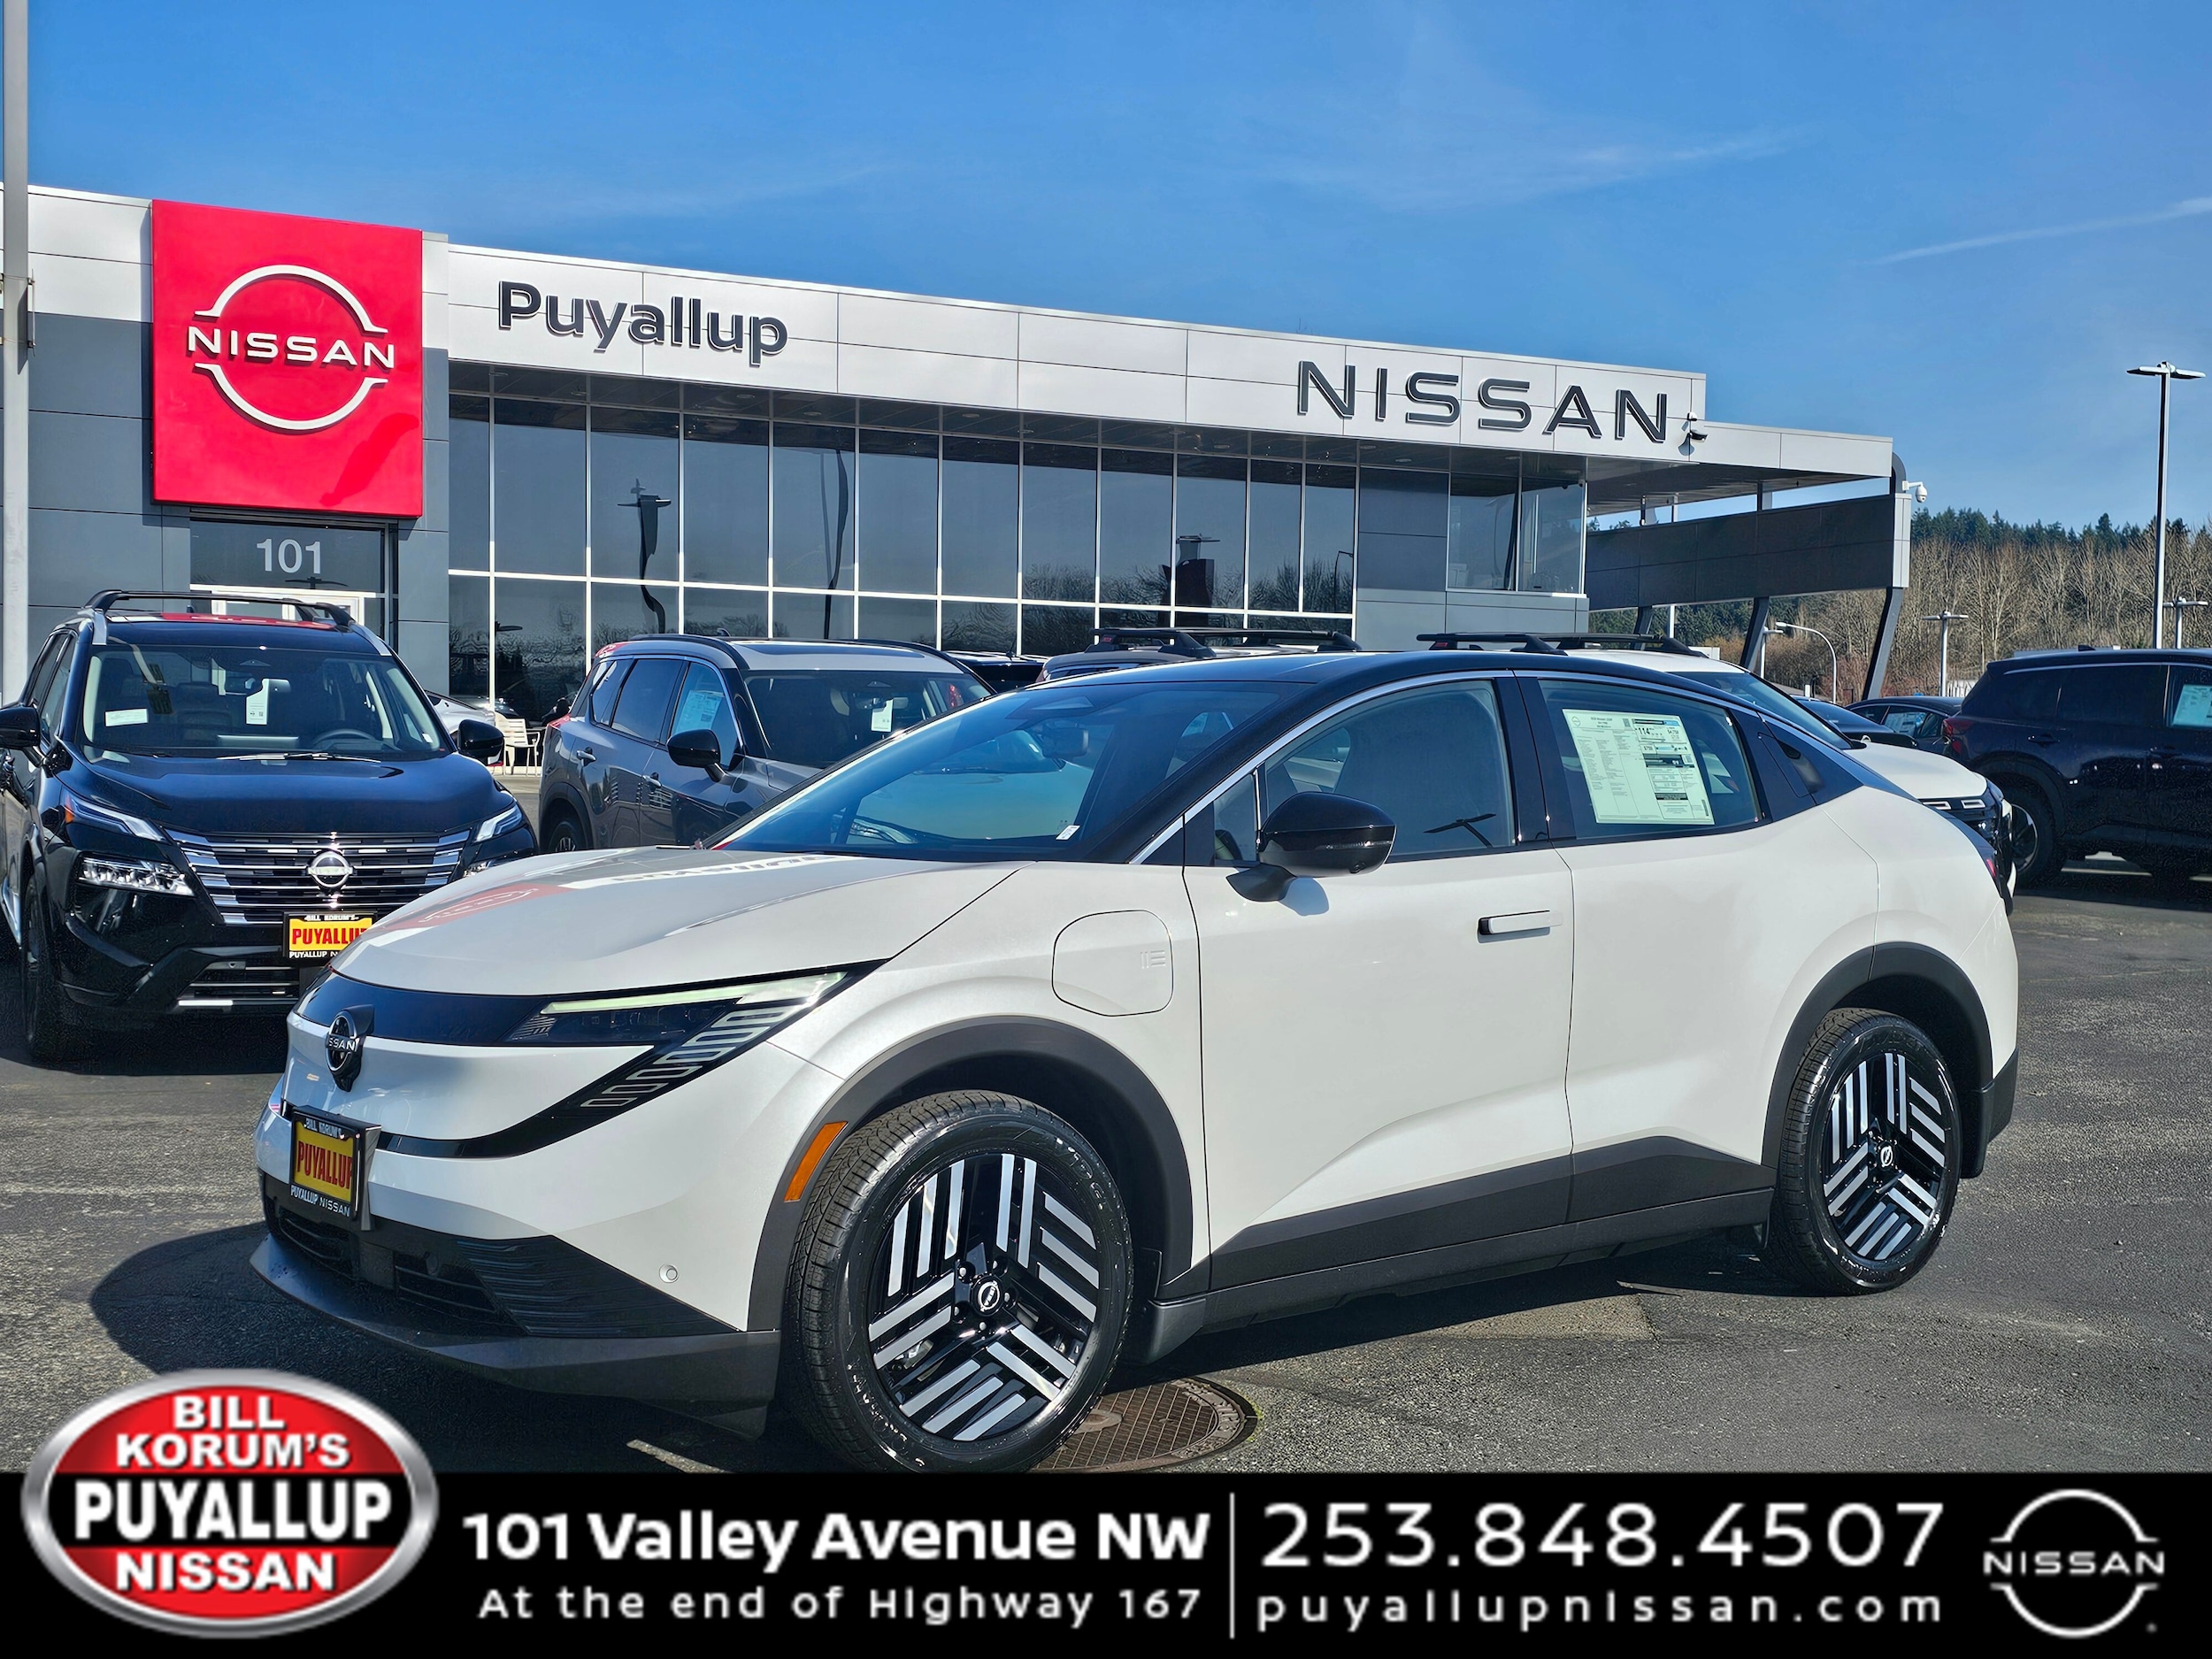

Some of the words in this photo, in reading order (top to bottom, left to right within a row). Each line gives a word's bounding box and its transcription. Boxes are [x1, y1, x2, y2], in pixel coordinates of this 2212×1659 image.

[498, 280, 788, 367] Puyallup
[187, 326, 396, 369] NISSAN
[1297, 360, 1668, 443] NISSAN
[257, 539, 322, 574] 101
[291, 1185, 319, 1205] PUYALLUP
[319, 1196, 351, 1217] NISSAN
